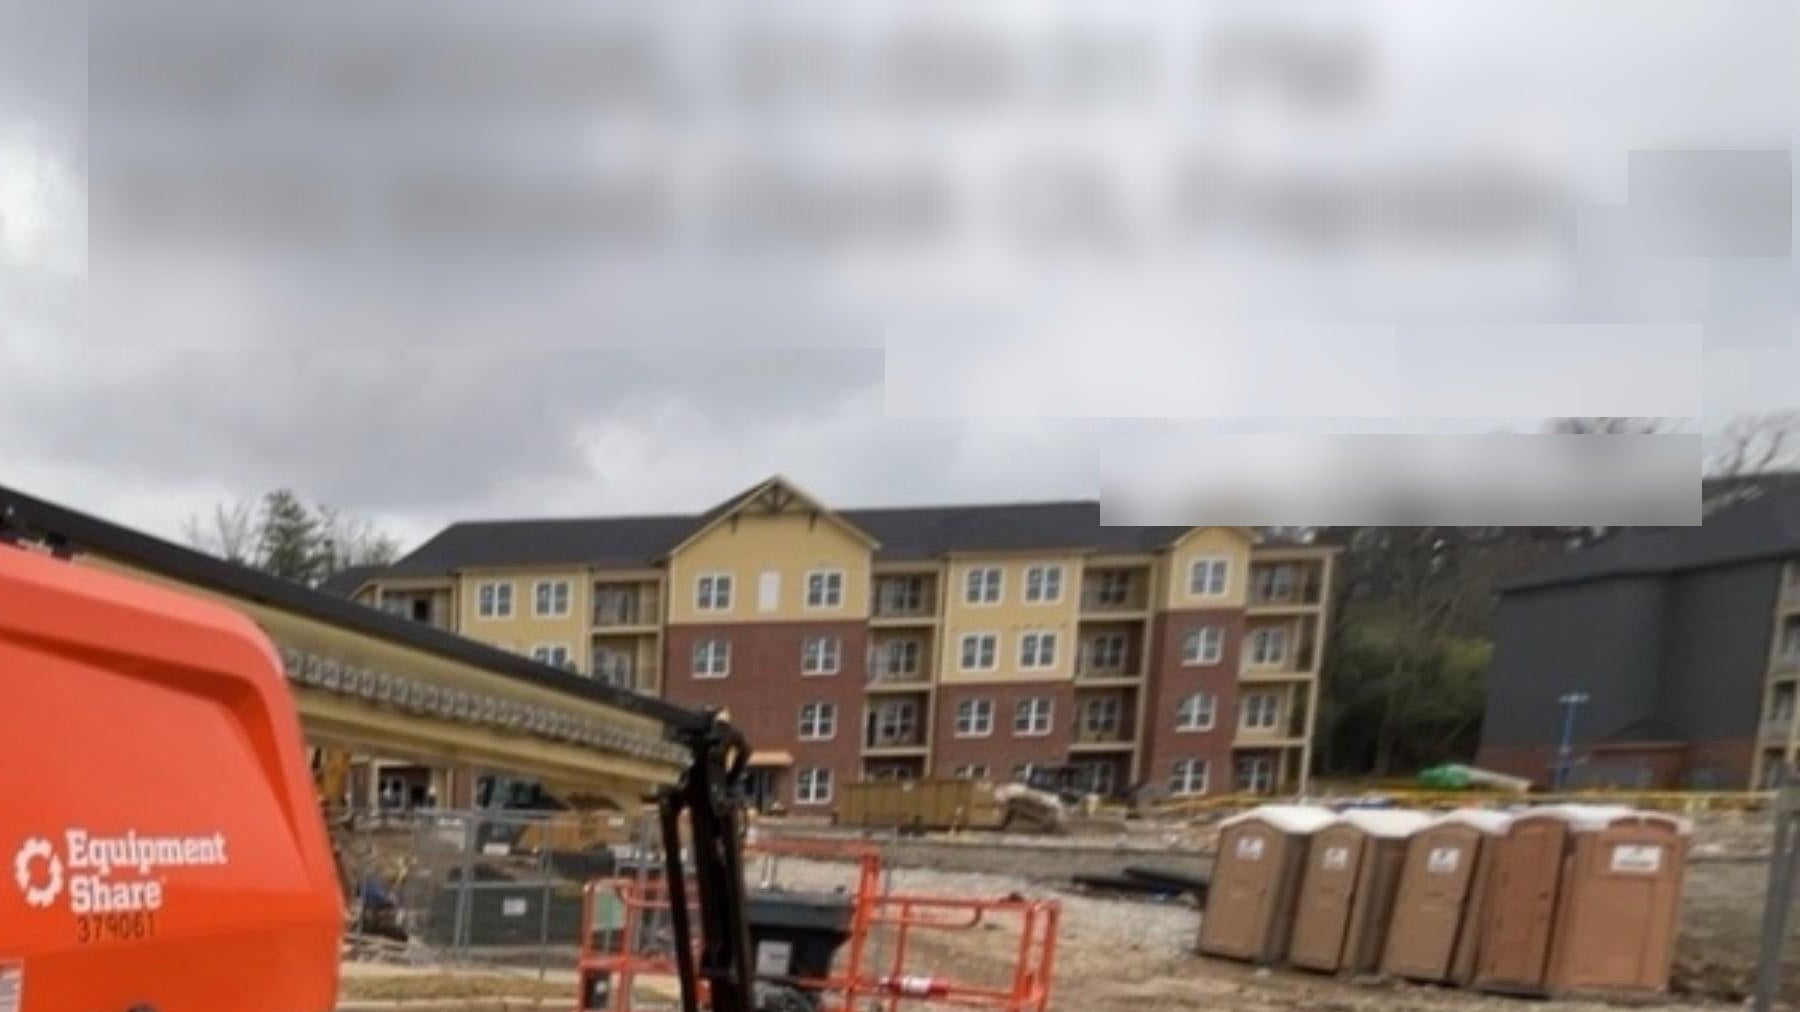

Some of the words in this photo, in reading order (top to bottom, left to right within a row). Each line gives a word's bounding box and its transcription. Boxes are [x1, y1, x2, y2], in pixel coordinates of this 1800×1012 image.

[64, 828, 229, 876] Equipment
[69, 875, 163, 914] Share
[77, 912, 156, 944] 379061
